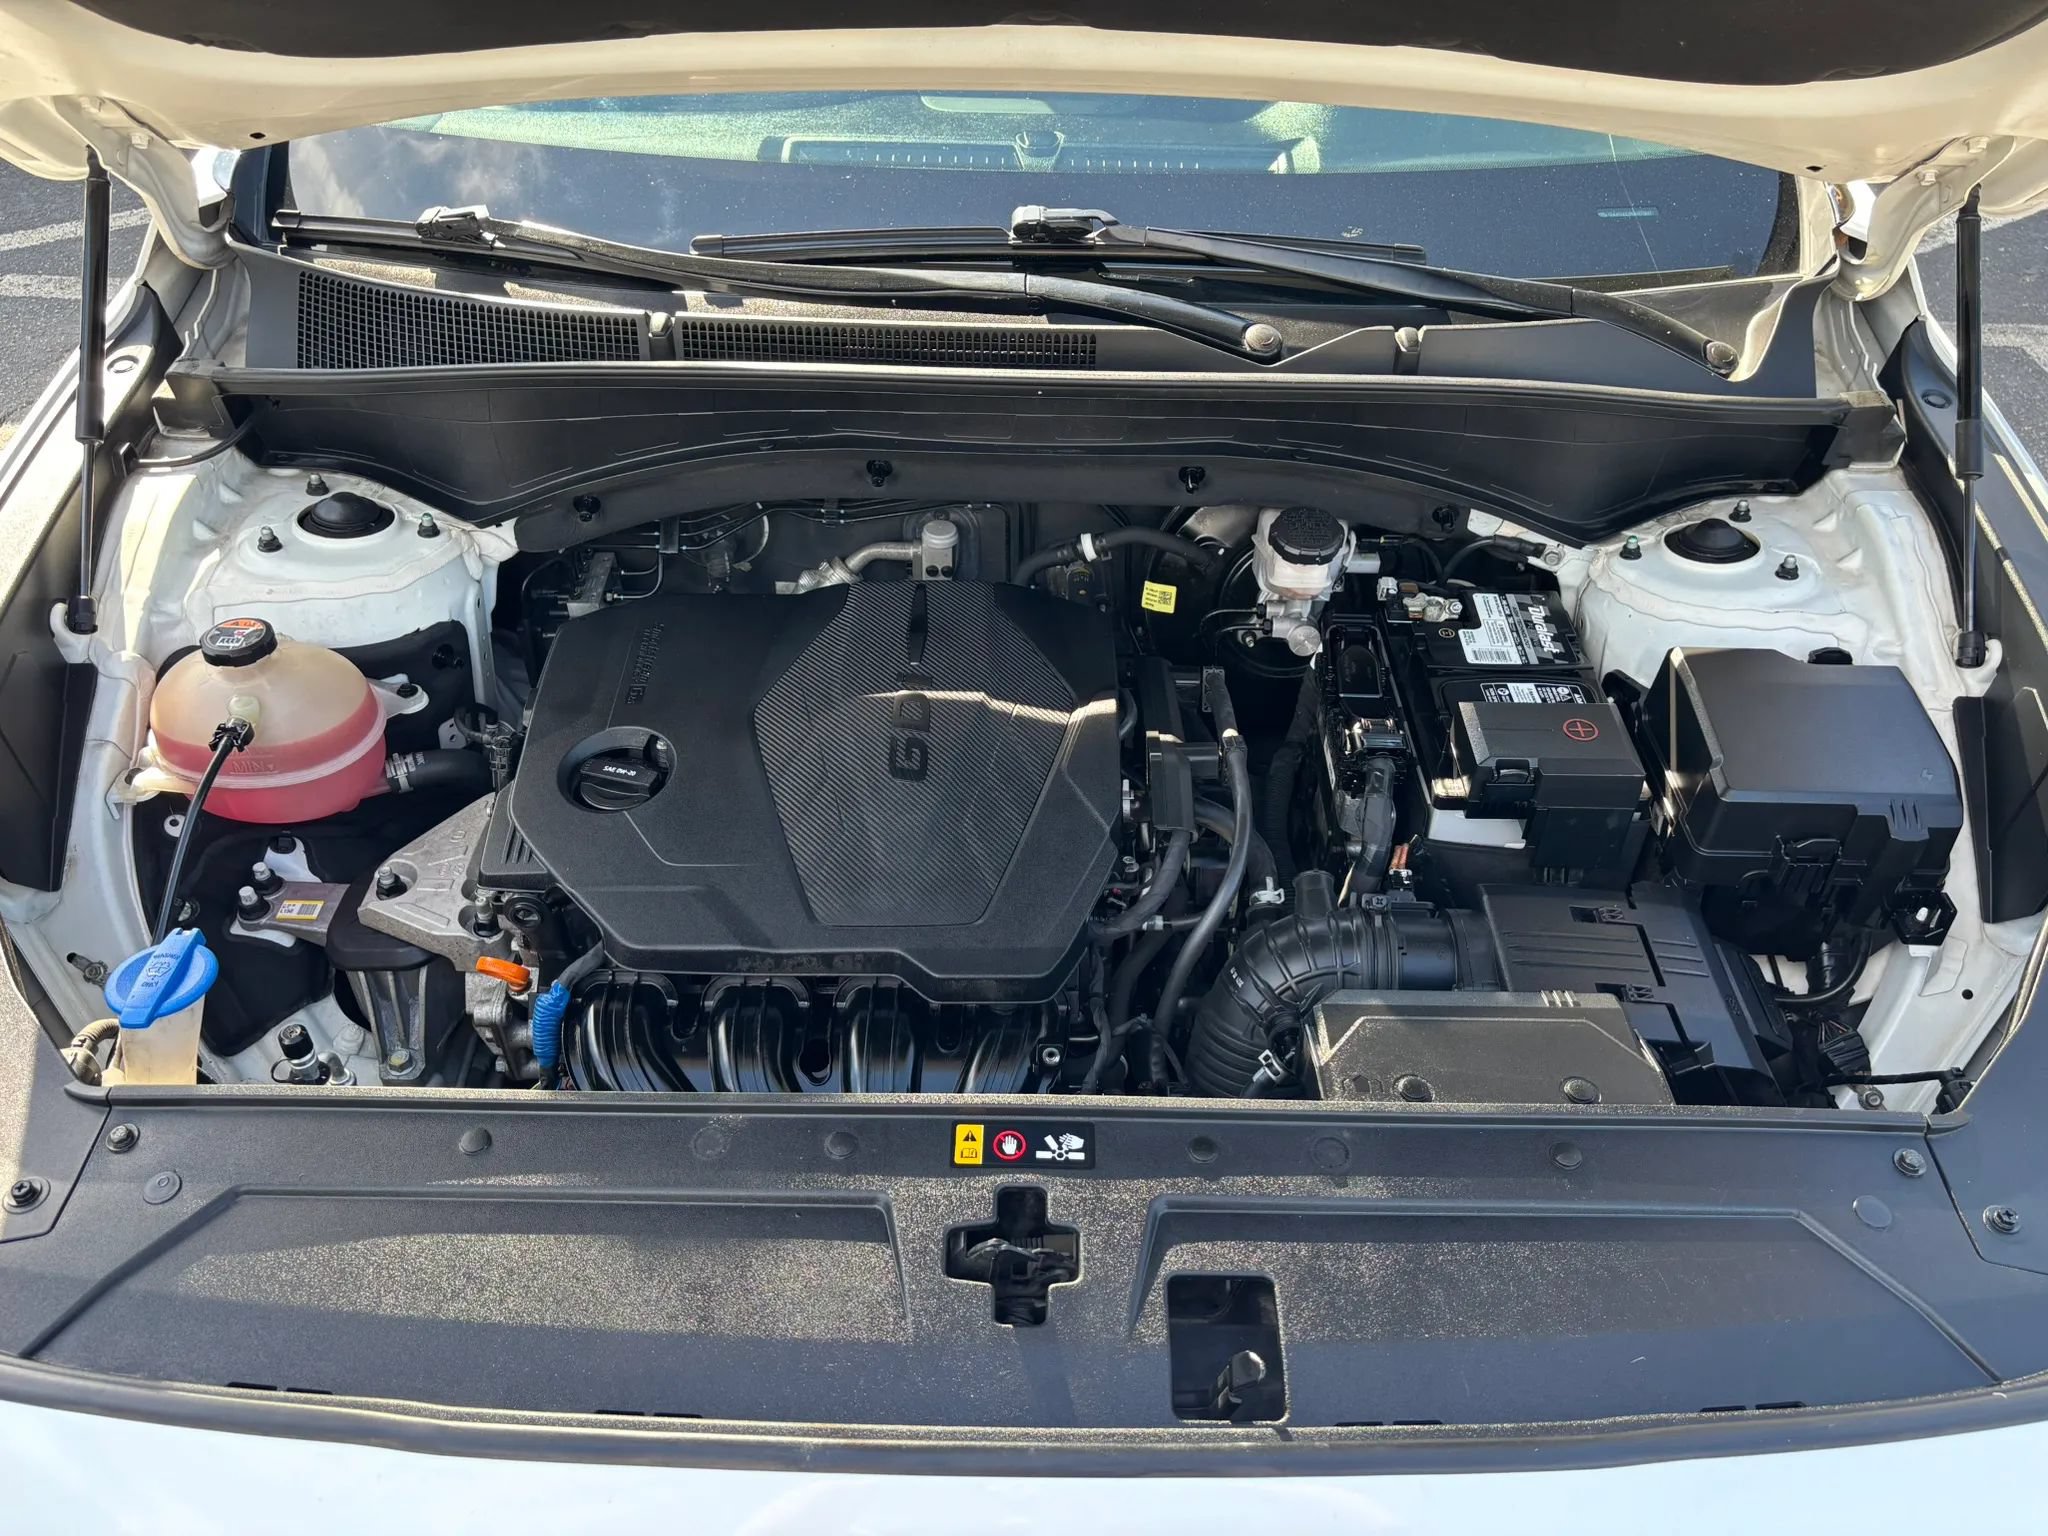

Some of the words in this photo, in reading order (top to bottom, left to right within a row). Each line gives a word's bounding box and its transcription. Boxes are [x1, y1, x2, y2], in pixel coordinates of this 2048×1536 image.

[1517, 619, 1531, 649] TECHNOLOGY
[1528, 606, 1560, 654] Duralast
[888, 673, 932, 783] GDI
[232, 761, 265, 772] MIN
[602, 765, 617, 773] SAE
